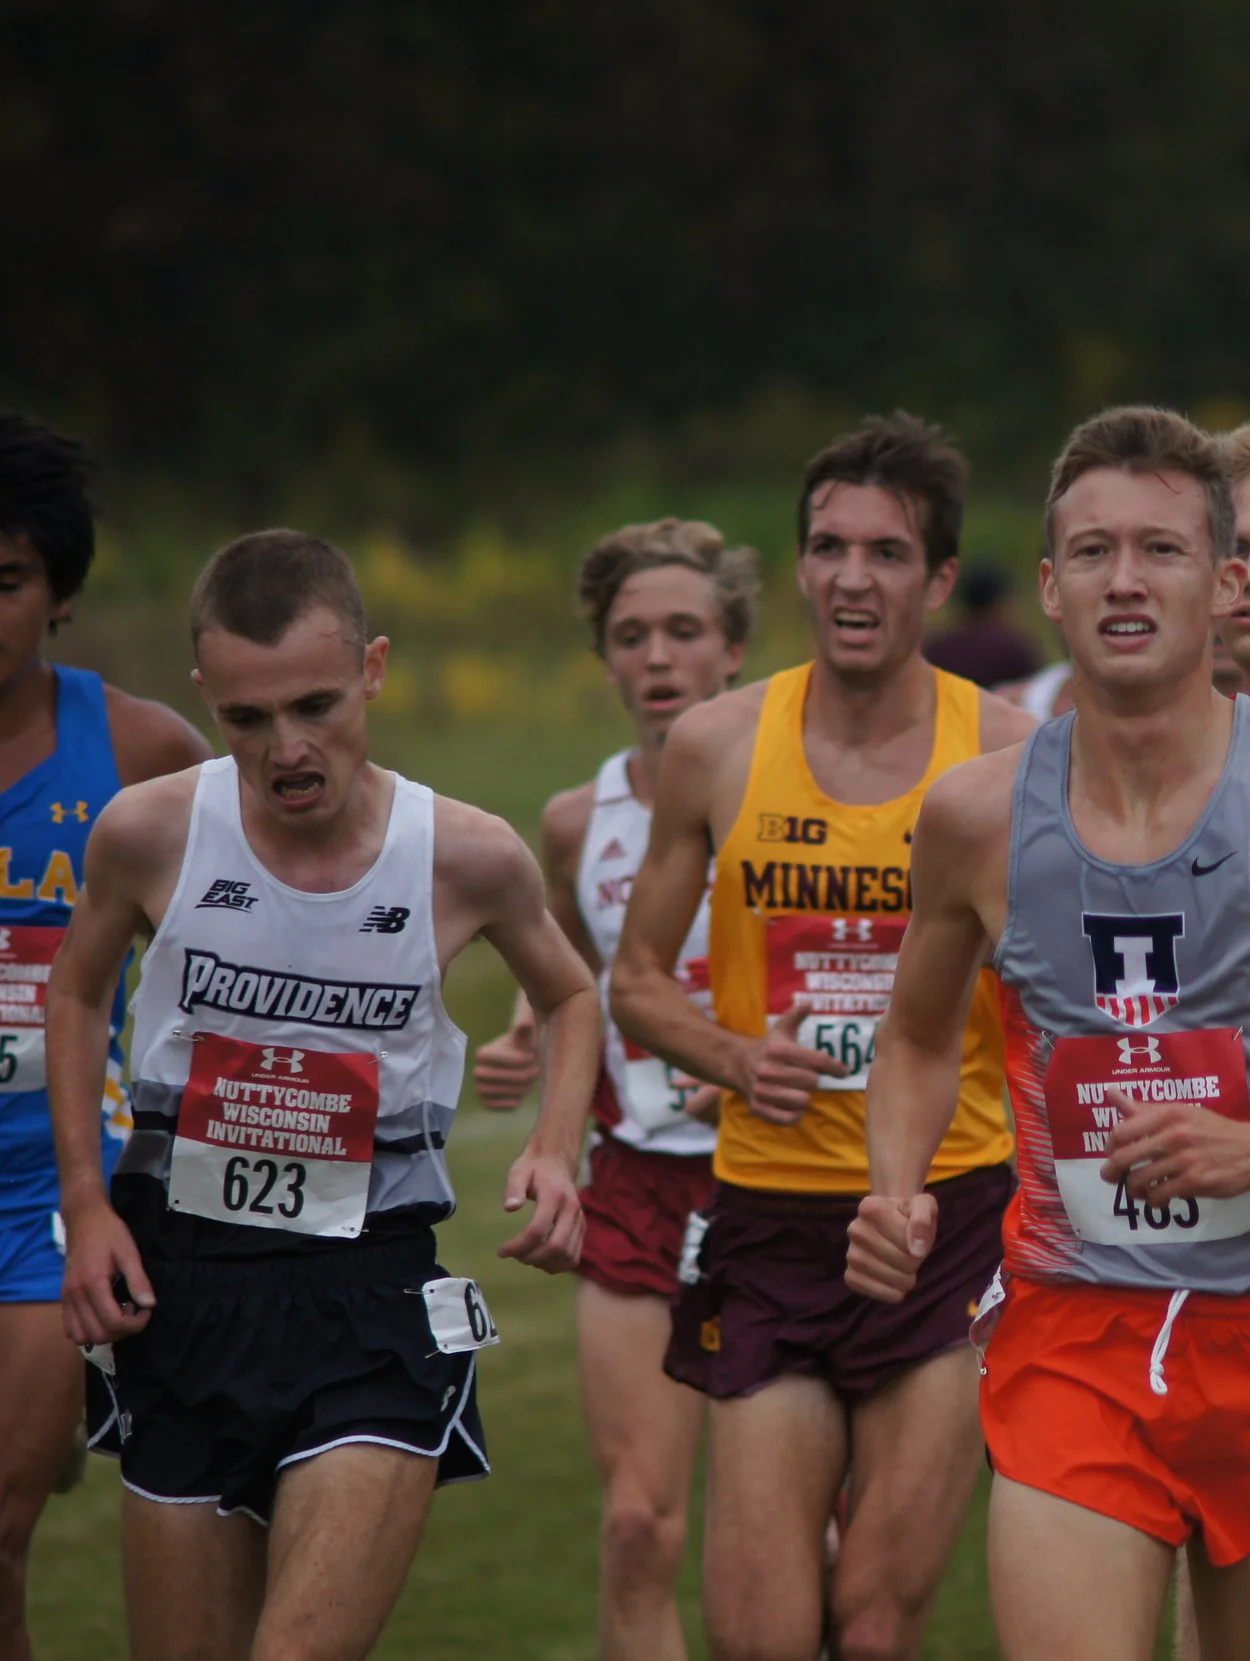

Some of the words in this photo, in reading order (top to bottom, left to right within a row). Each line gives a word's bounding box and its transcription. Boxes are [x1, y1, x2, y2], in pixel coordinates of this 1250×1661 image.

[201, 892, 259, 909] EAST
[210, 879, 250, 894] BIG
[741, 860, 912, 912] MINNES
[180, 949, 419, 1029] PROVIDENCE
[1140, 1066, 1171, 1074] ARMOUR
[213, 1077, 352, 1113] NUTTYCOMBE
[223, 1102, 331, 1133] WISCONSIN
[206, 1120, 347, 1155] INVITATIONAL
[223, 1156, 306, 1218] 623
